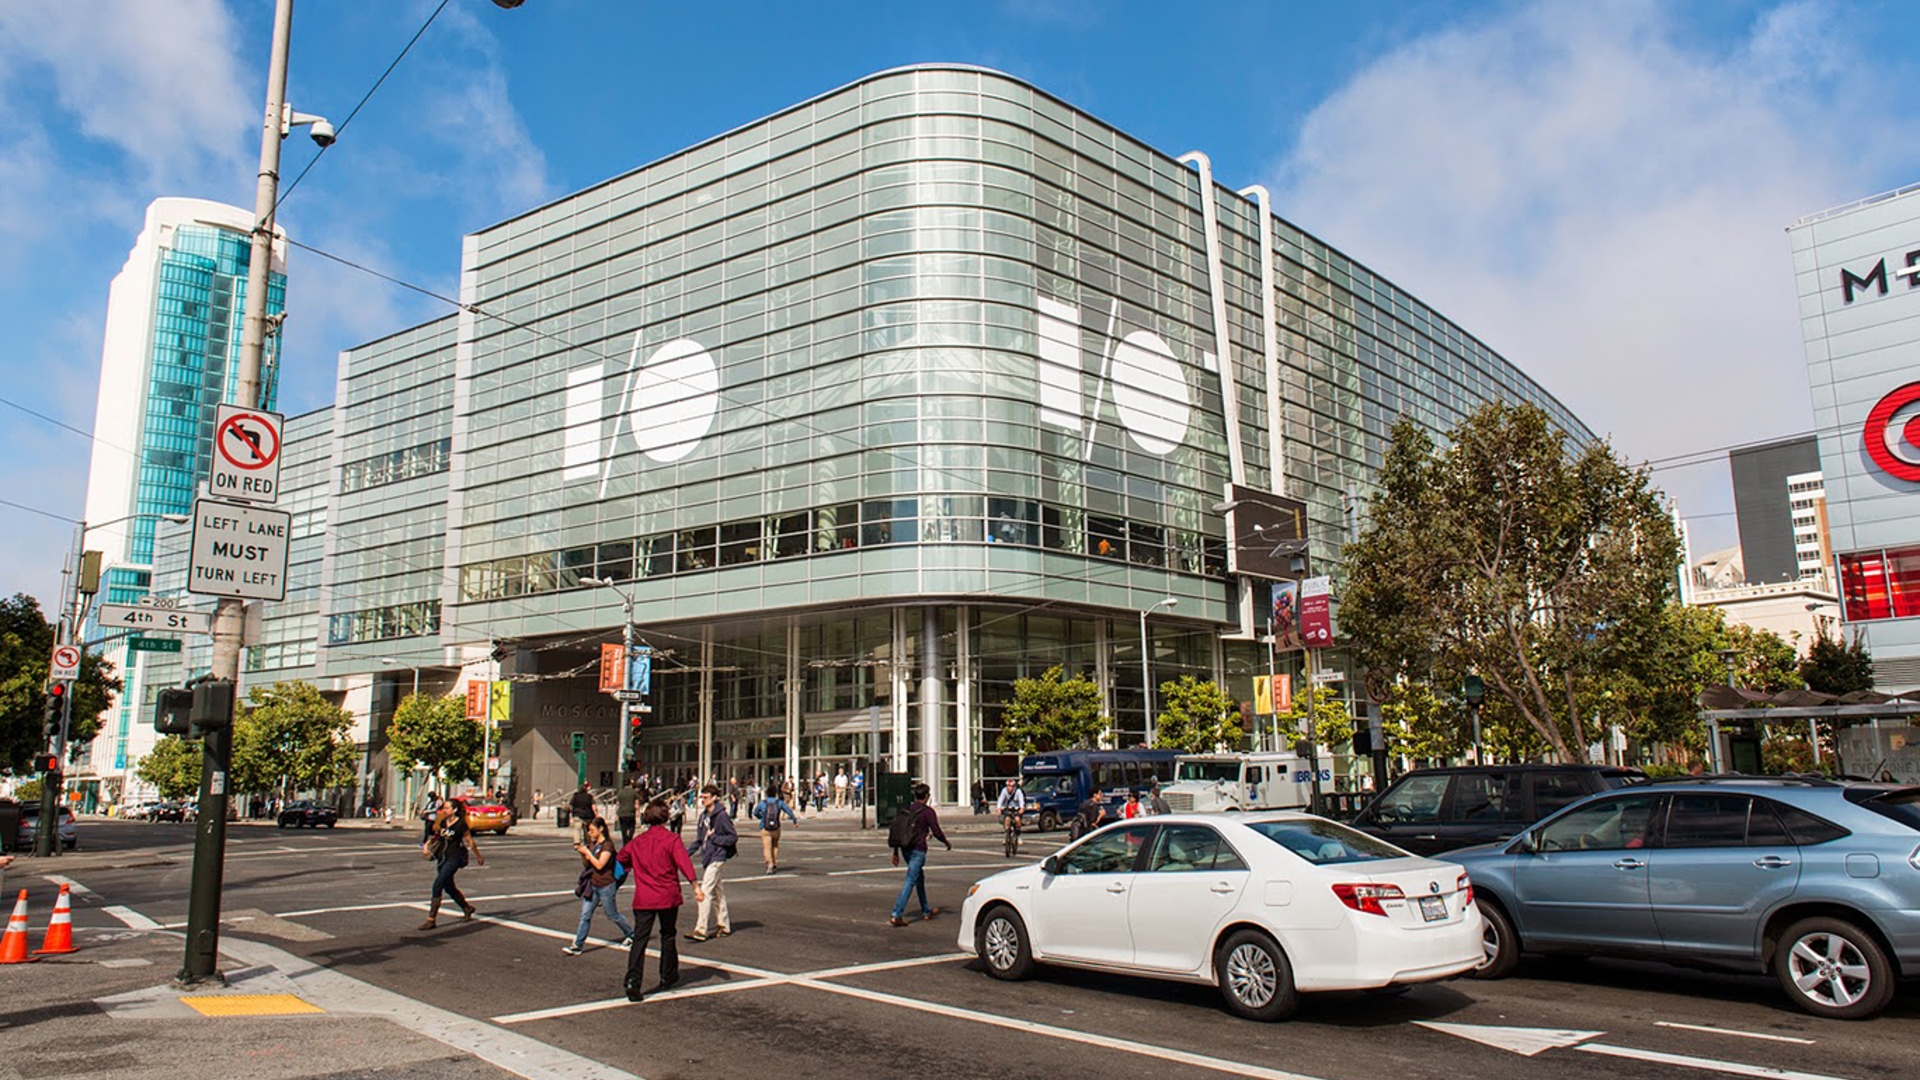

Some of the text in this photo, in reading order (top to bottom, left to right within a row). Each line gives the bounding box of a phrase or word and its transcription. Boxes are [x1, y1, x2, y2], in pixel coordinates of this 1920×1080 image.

[563, 329, 719, 500] I/O
[216, 472, 273, 494] ON RED
[204, 516, 285, 538] LEFT LANE
[212, 541, 269, 562] MUST
[196, 565, 277, 586] TURN LEFT
[153, 599, 174, 609] 200
[123, 611, 188, 628] 4th St
[138, 640, 174, 650] 4th St
[542, 704, 618, 718] MOSCON
[560, 733, 610, 746] WST
[1298, 769, 1331, 782] BRKS
